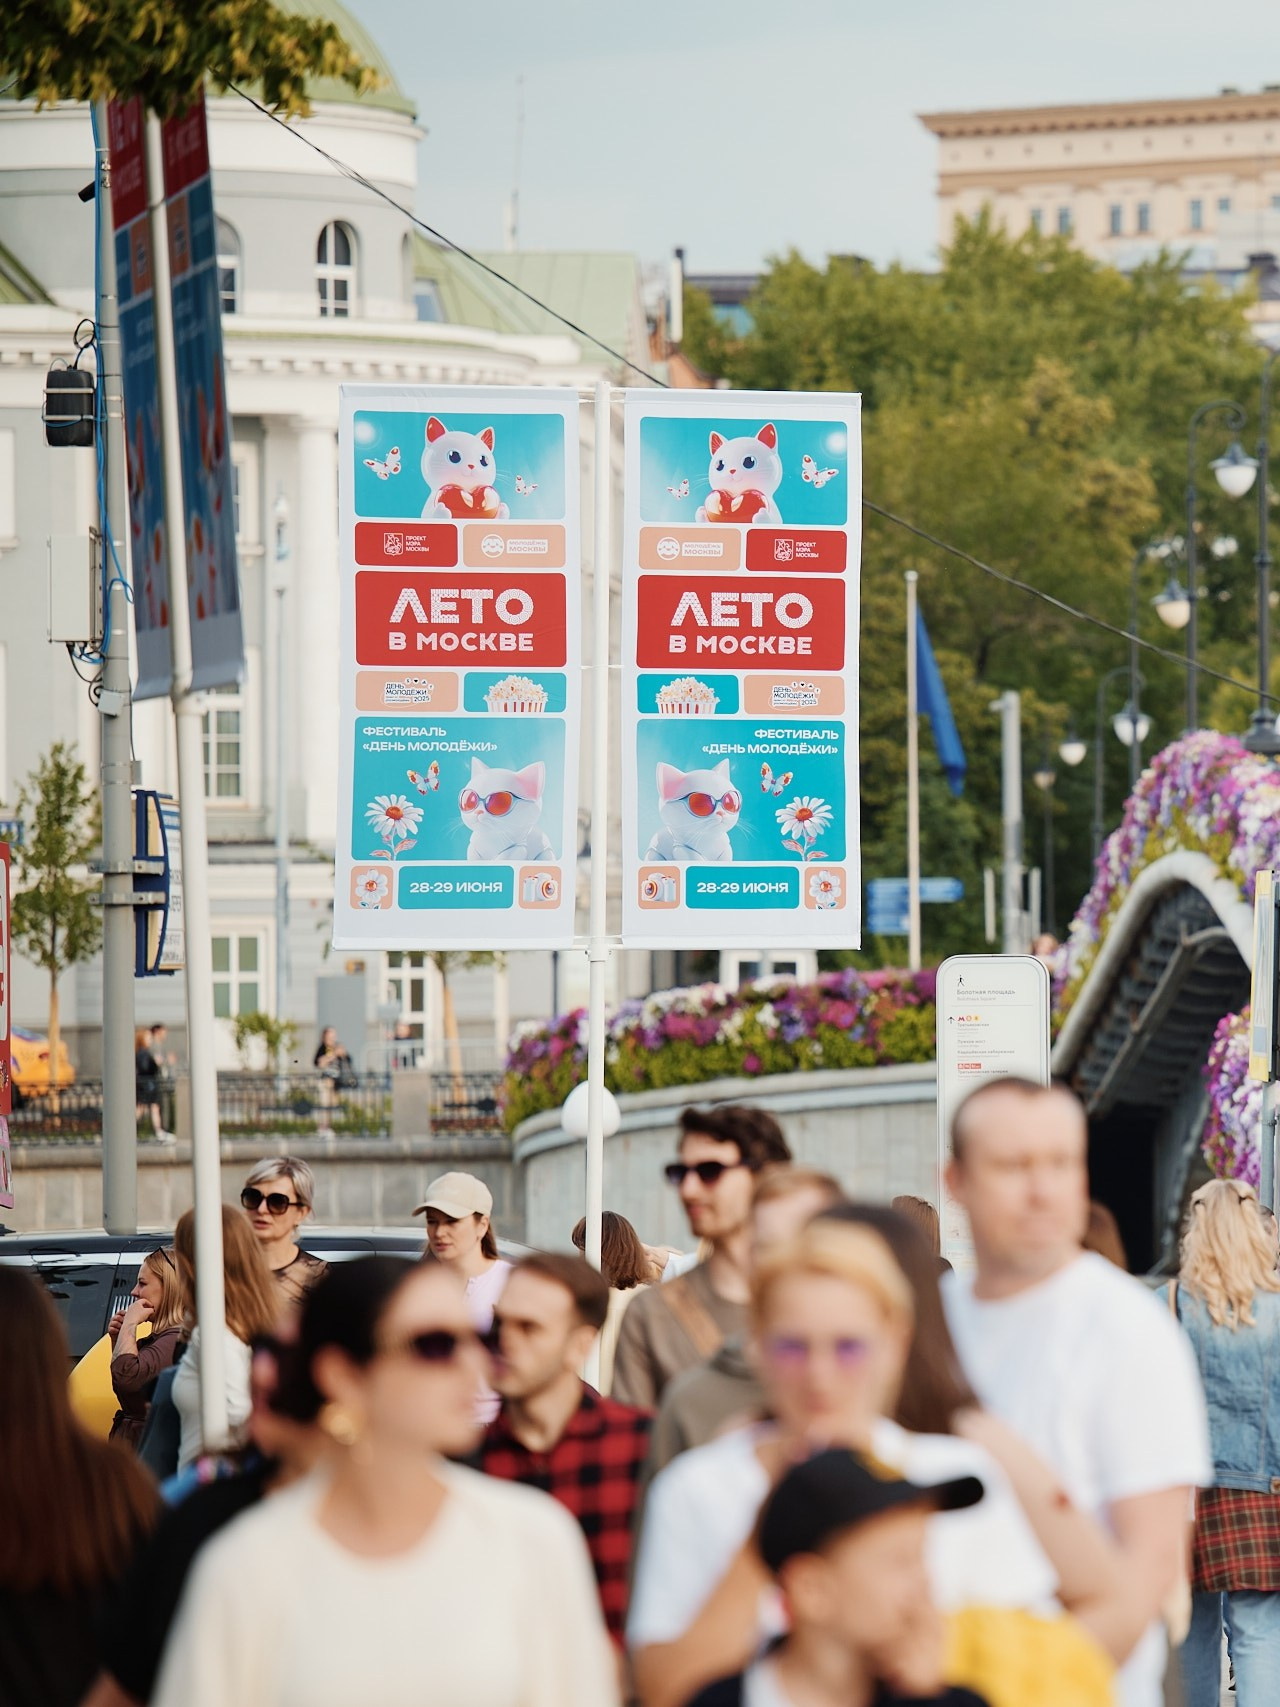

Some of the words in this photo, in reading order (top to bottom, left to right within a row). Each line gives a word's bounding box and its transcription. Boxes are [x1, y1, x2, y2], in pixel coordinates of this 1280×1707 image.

[389, 588, 534, 626] ЛЕТО
[670, 592, 814, 629] ЛЕТО
[388, 632, 407, 650] В
[416, 632, 534, 652] МОСКВЕ
[668, 635, 687, 653] В
[696, 635, 812, 654] МОСКВЕ
[362, 726, 447, 737] ФЕСТИВАЛЬ
[754, 729, 840, 740] ФЕСТИВАЛЬ
[362, 741, 406, 752] «ДЕНЬ
[408, 740, 498, 752] МОЛОДЁЖИ»
[702, 744, 746, 754] «ДЕНЬ
[748, 743, 839, 755] МОЛОДЁЖИ»
[409, 882, 454, 893] 28-29
[456, 882, 503, 893] ИЮНЯ
[696, 882, 740, 893] 28-29
[742, 882, 789, 893] ИЮНЯ
